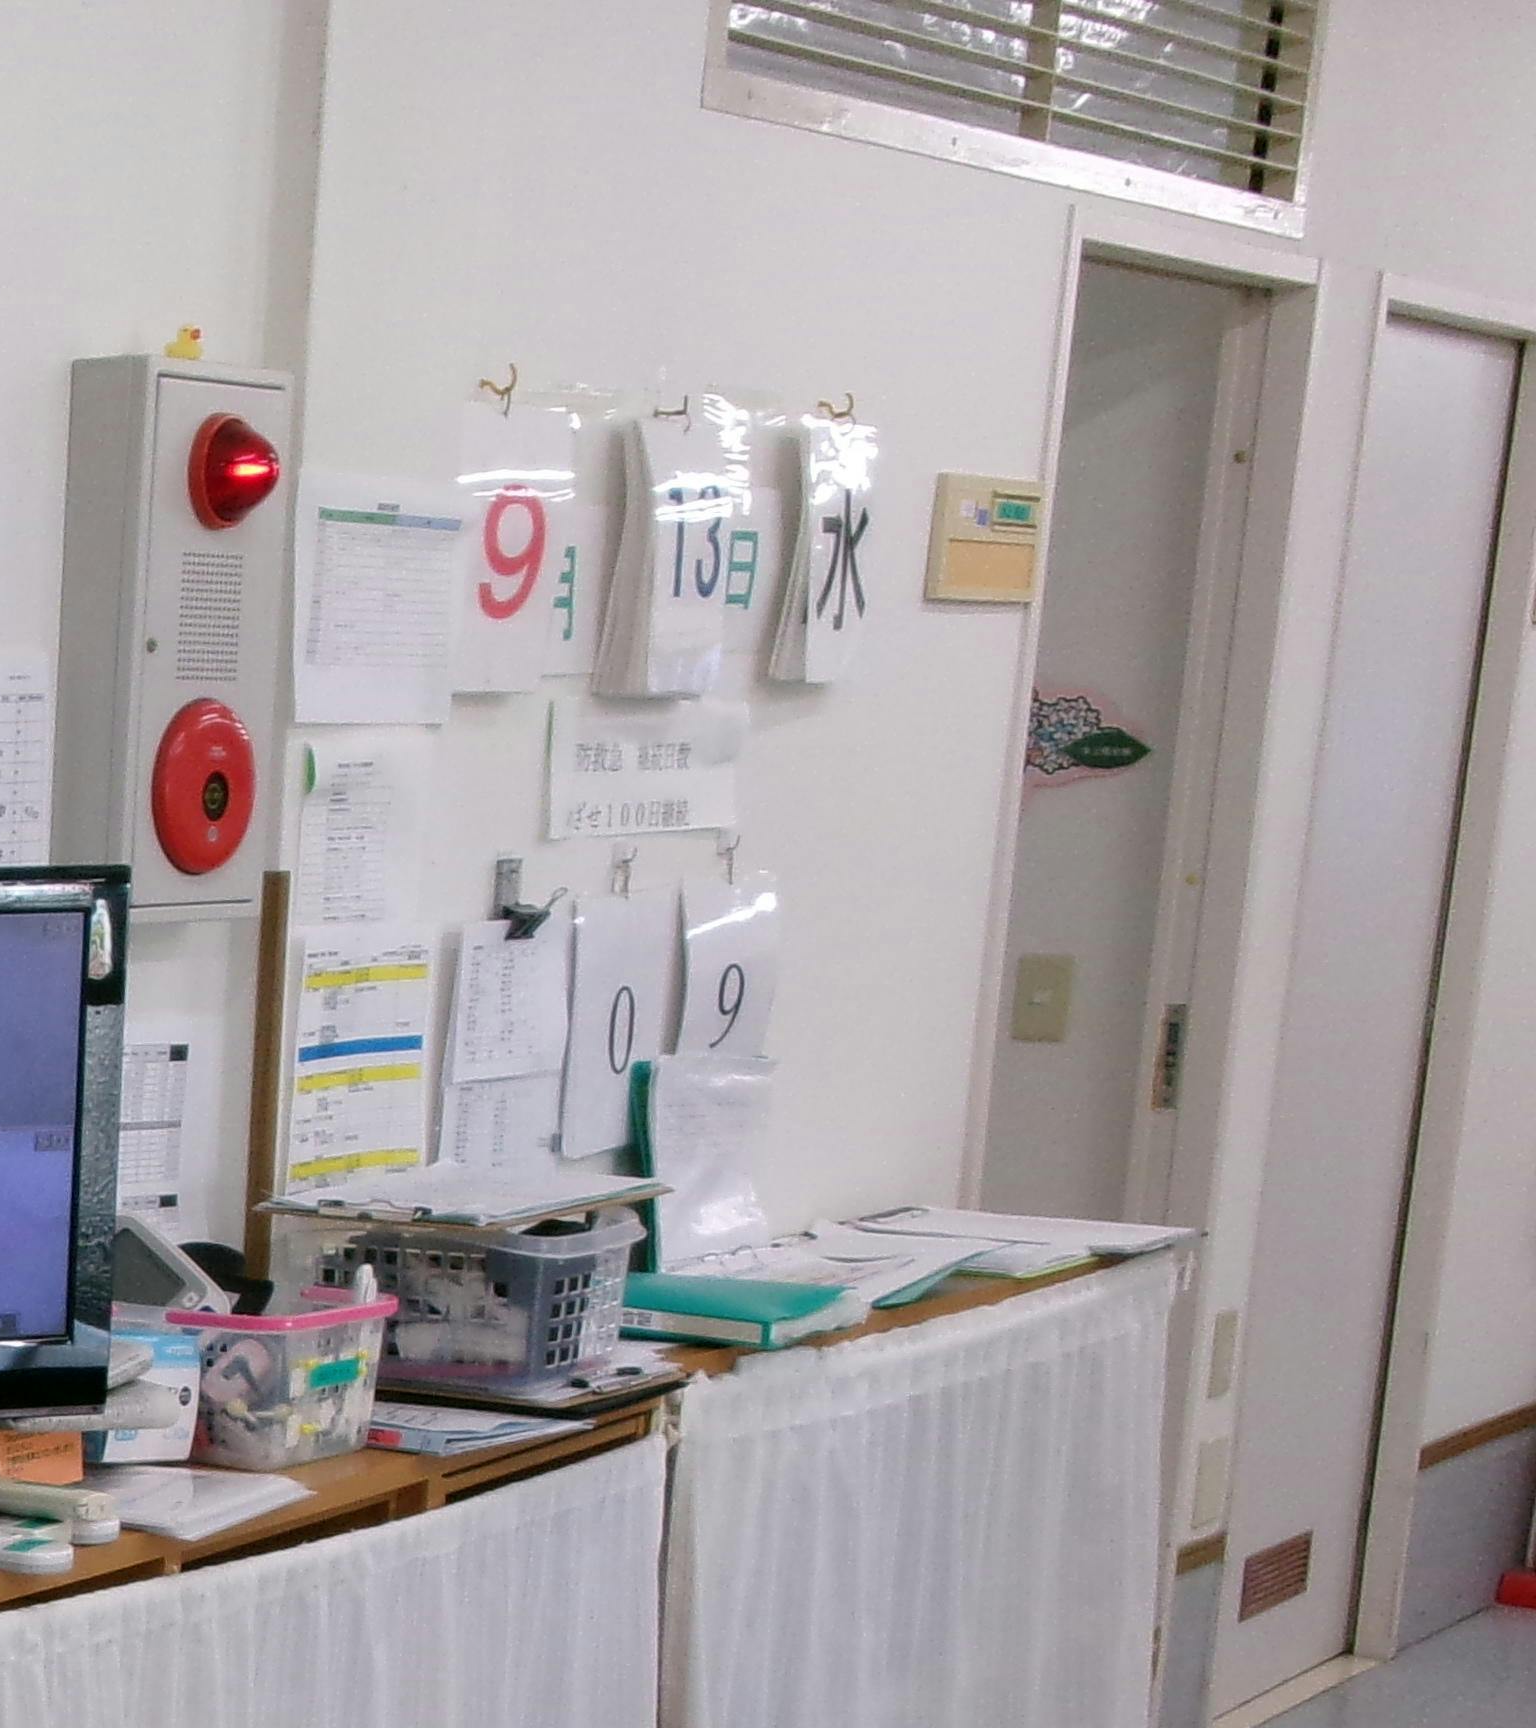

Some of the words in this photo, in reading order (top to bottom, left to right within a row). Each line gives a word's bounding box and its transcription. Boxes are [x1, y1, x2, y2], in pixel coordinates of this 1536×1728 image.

[477, 483, 548, 621] 9
[665, 485, 724, 601] 13
[725, 529, 759, 612] 日
[816, 488, 871, 632] 水
[607, 984, 637, 1075] 0
[711, 961, 746, 1050] 9
